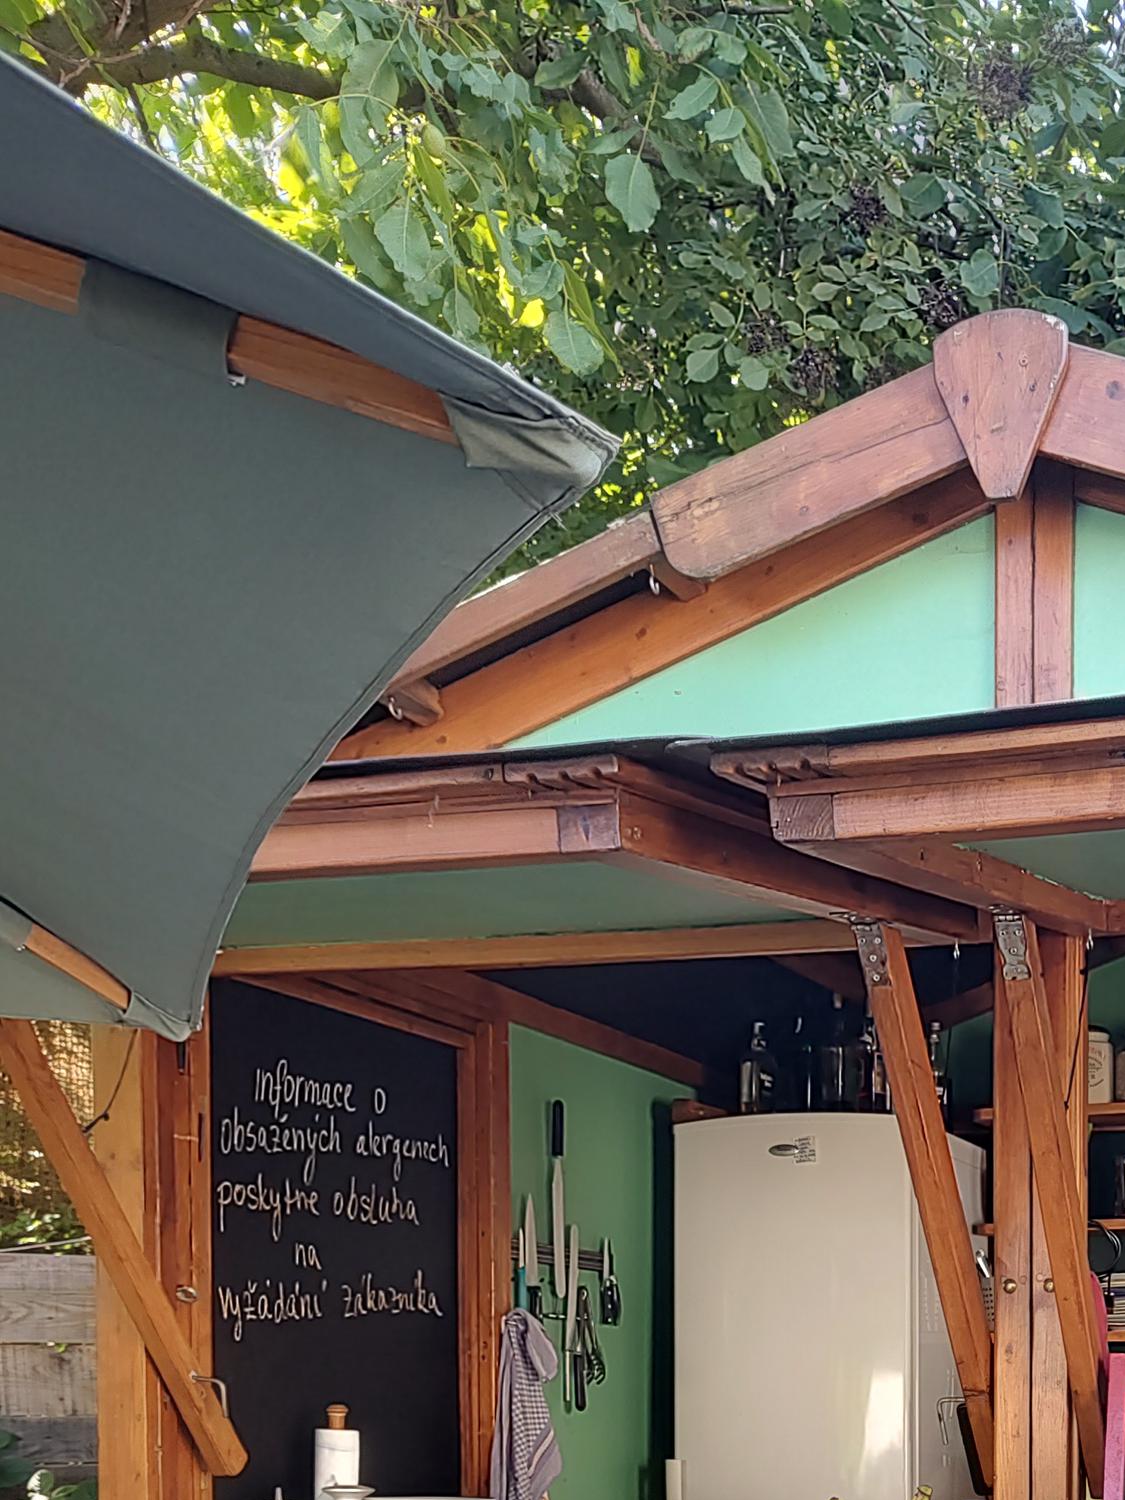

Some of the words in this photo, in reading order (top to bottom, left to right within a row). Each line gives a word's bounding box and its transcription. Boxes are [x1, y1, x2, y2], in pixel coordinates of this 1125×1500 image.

[255, 1059, 356, 1118] Informace
[356, 1121, 450, 1181] alergenech
[217, 1174, 320, 1242] poskytne
[333, 1176, 420, 1226] obsluha
[295, 1242, 322, 1270] na
